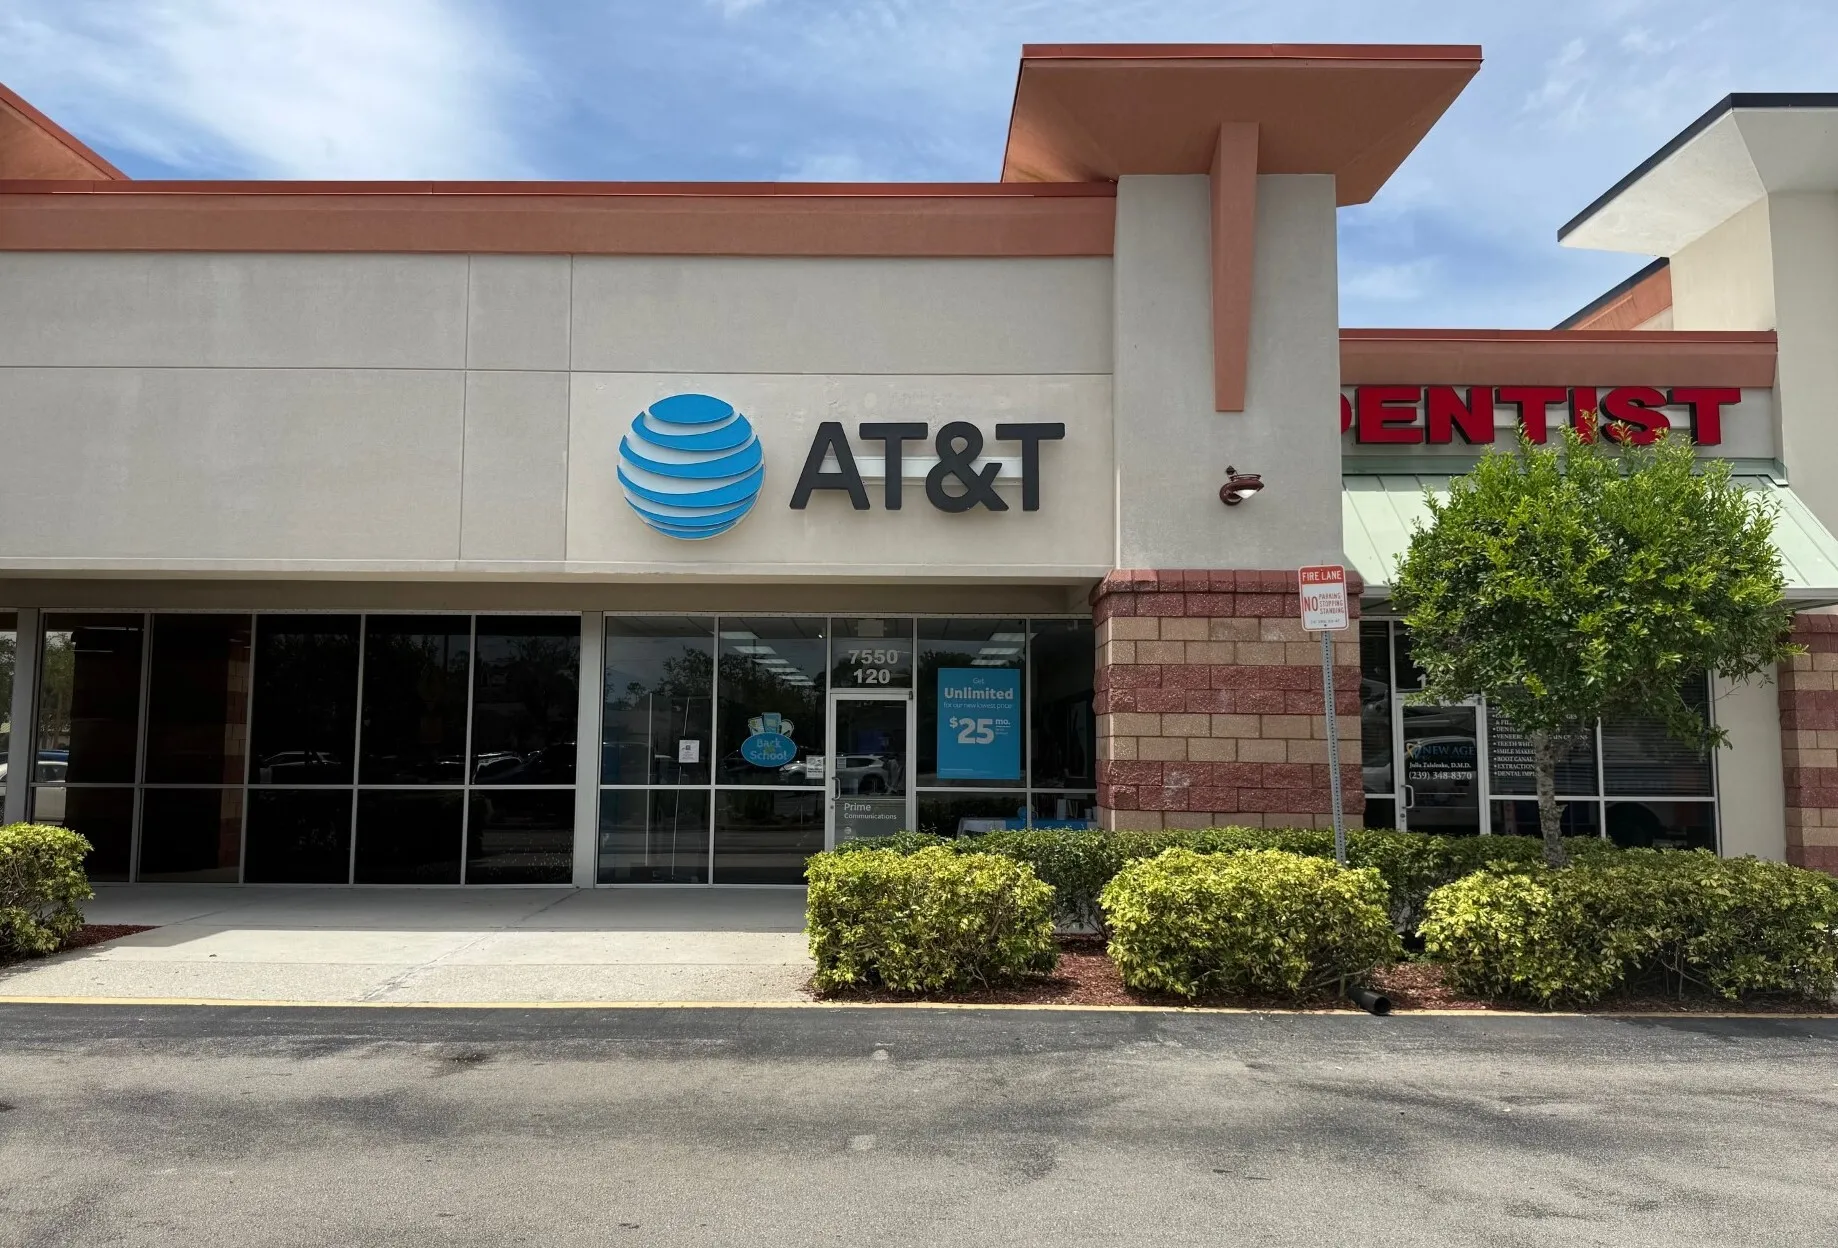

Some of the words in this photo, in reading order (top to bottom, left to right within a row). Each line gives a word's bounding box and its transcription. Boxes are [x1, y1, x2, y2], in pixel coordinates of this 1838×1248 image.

[789, 421, 1065, 513] AT&T
[1302, 571, 1320, 581] FIRE
[1321, 570, 1342, 580] LANE
[1304, 596, 1318, 611] NO
[1319, 592, 1342, 600] PARKING
[1319, 600, 1344, 608] STOPPING
[1320, 607, 1344, 615] STANDING
[848, 649, 898, 664] 7550
[853, 668, 891, 684] 120
[944, 687, 1014, 700] Unlimited
[949, 716, 995, 745] $25
[757, 737, 781, 748] Back
[750, 750, 787, 760] School
[1422, 745, 1449, 755] NEW
[1452, 745, 1476, 756] AGE
[1408, 771, 1430, 781] (239)
[1432, 771, 1473, 780] 348-8370
[844, 802, 872, 811] Prime
[844, 812, 897, 820] Communications
